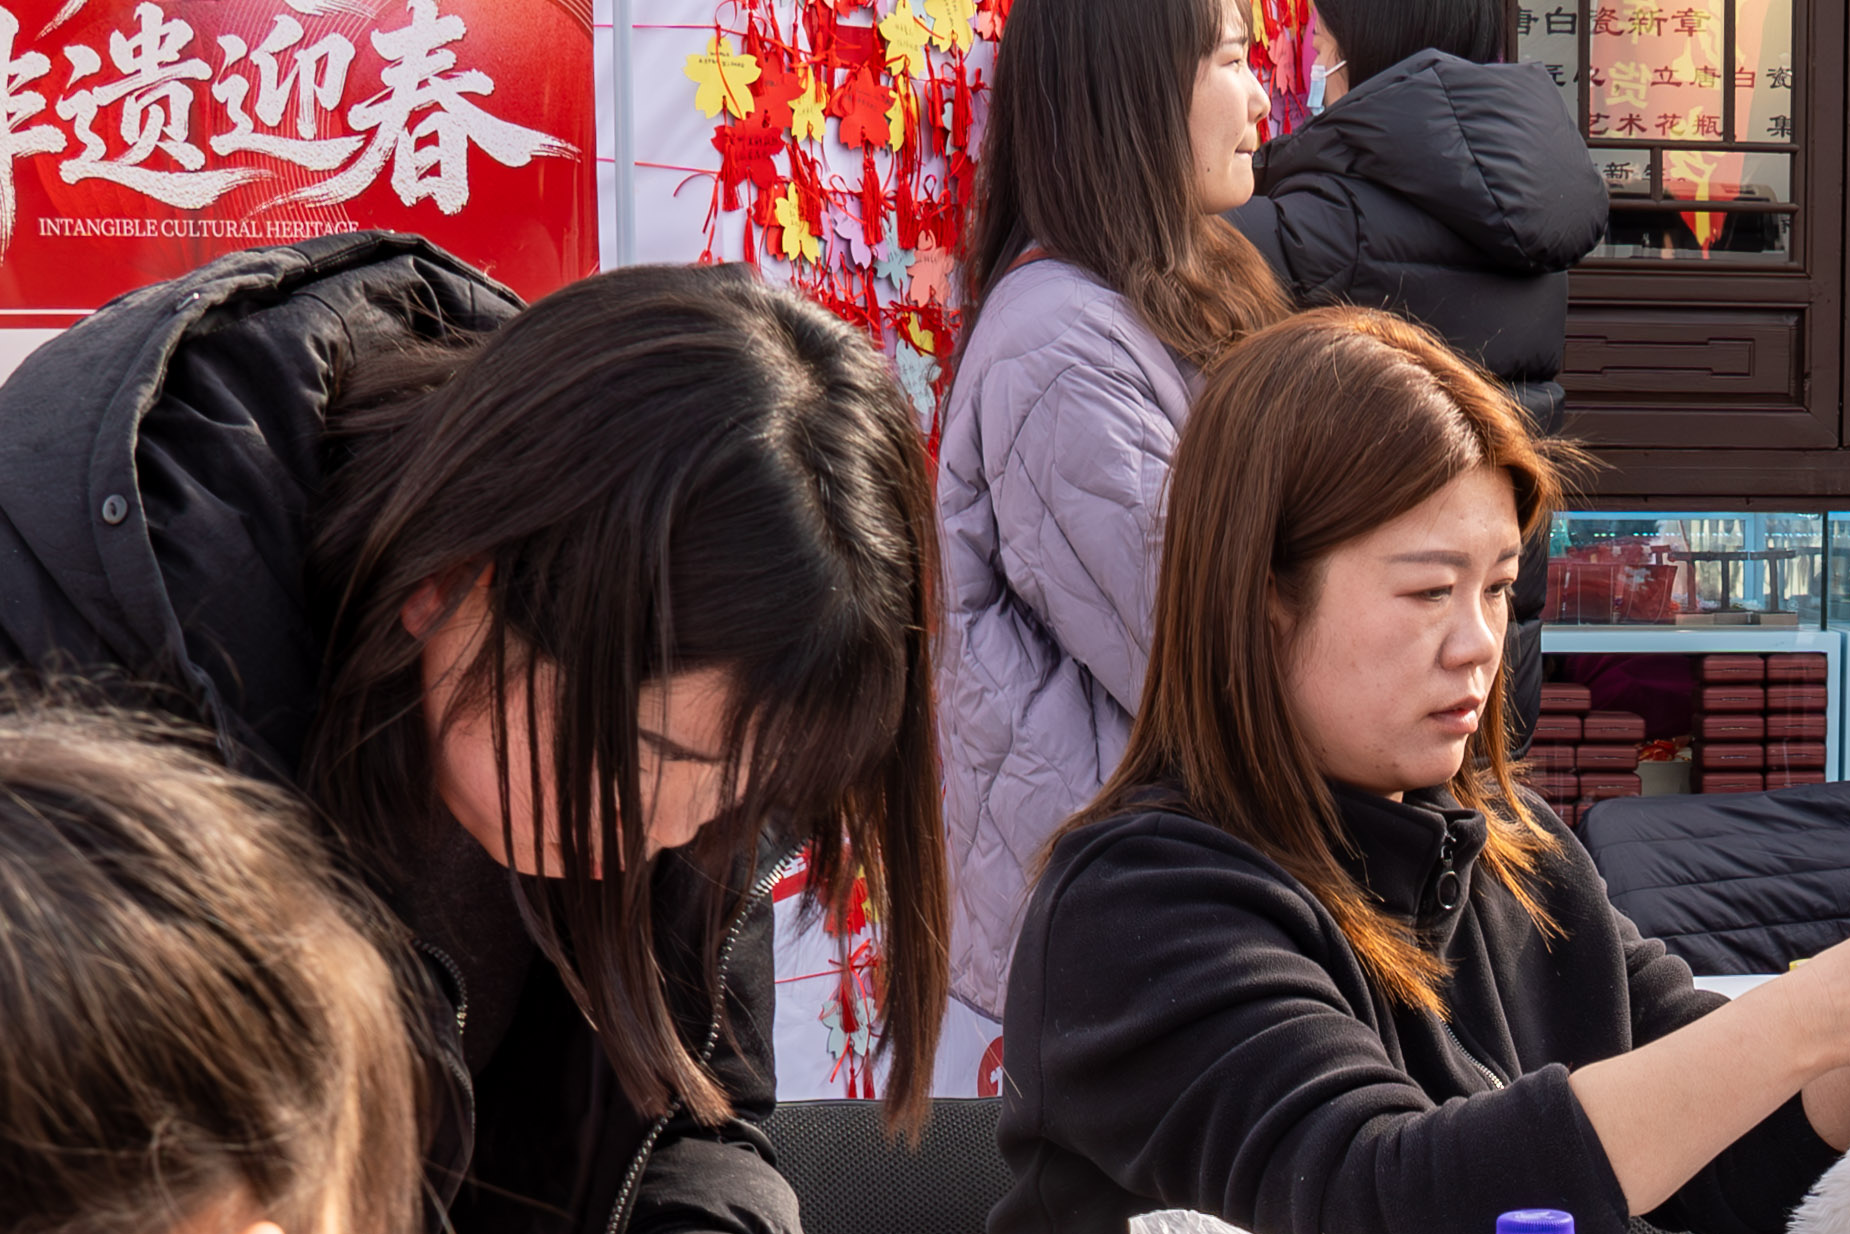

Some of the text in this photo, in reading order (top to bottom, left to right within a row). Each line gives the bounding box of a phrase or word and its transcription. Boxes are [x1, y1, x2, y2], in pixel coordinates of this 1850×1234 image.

[38, 217, 359, 238] INTANGIBLE CULTURAL HERITAGE
